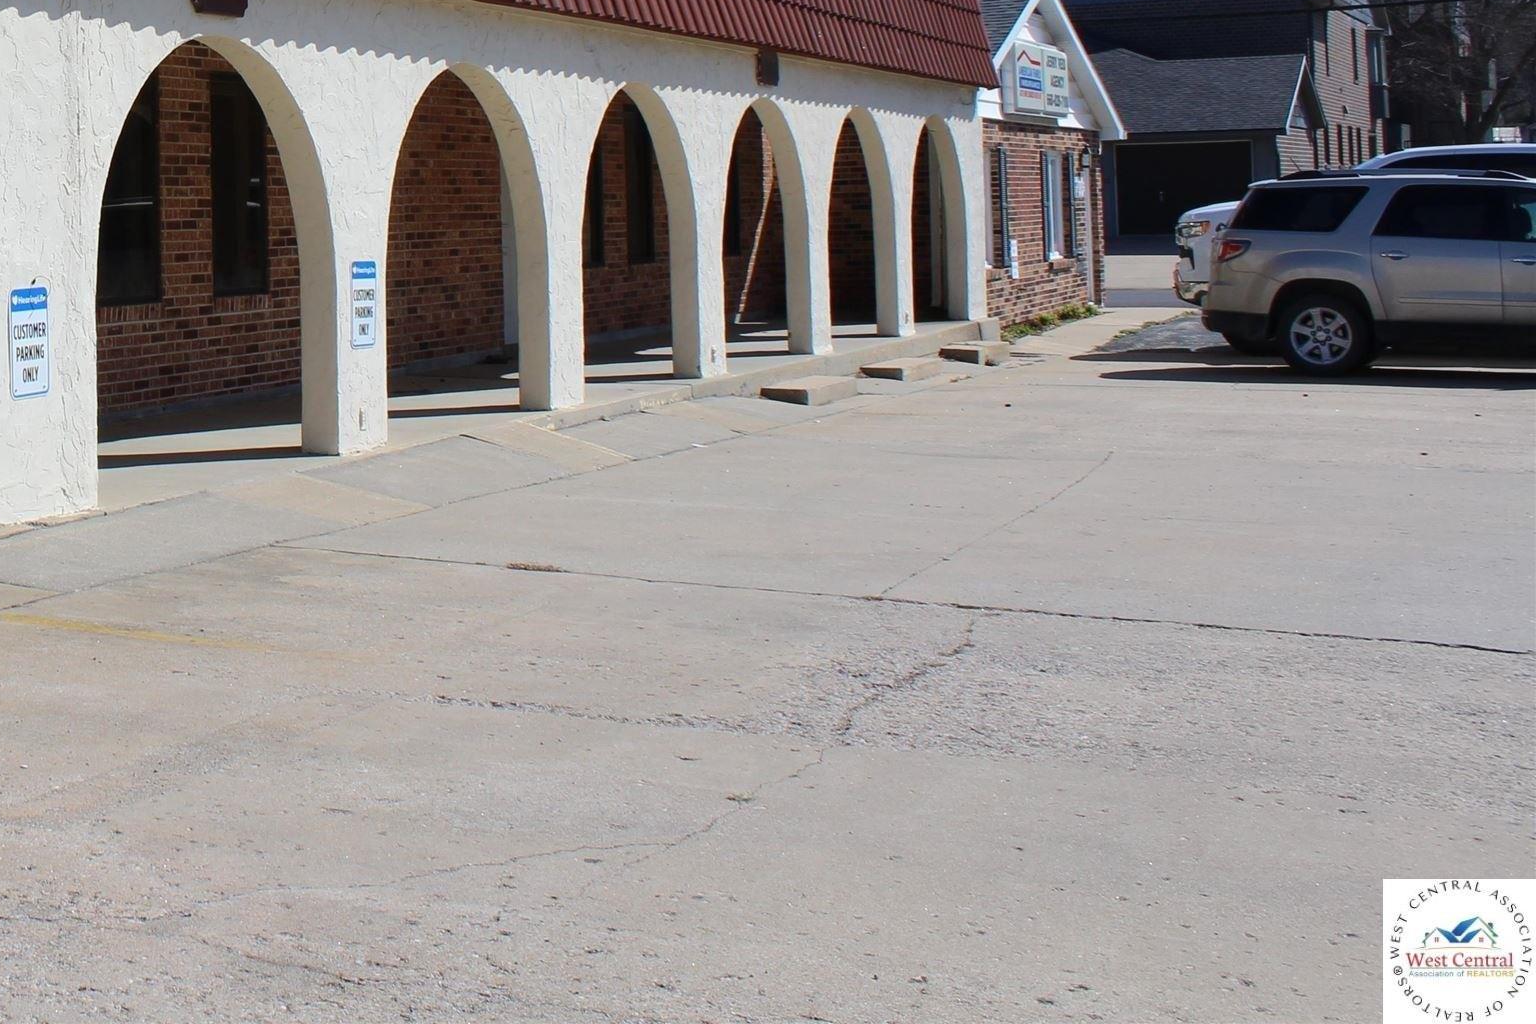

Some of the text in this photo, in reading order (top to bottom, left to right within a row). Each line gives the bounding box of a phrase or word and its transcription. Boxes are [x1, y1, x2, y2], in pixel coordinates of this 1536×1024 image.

[354, 289, 374, 301] CUSTOMER
[13, 322, 46, 340] CUSTOMER
[16, 344, 45, 362] PARKING
[23, 366, 39, 382] ONLY
